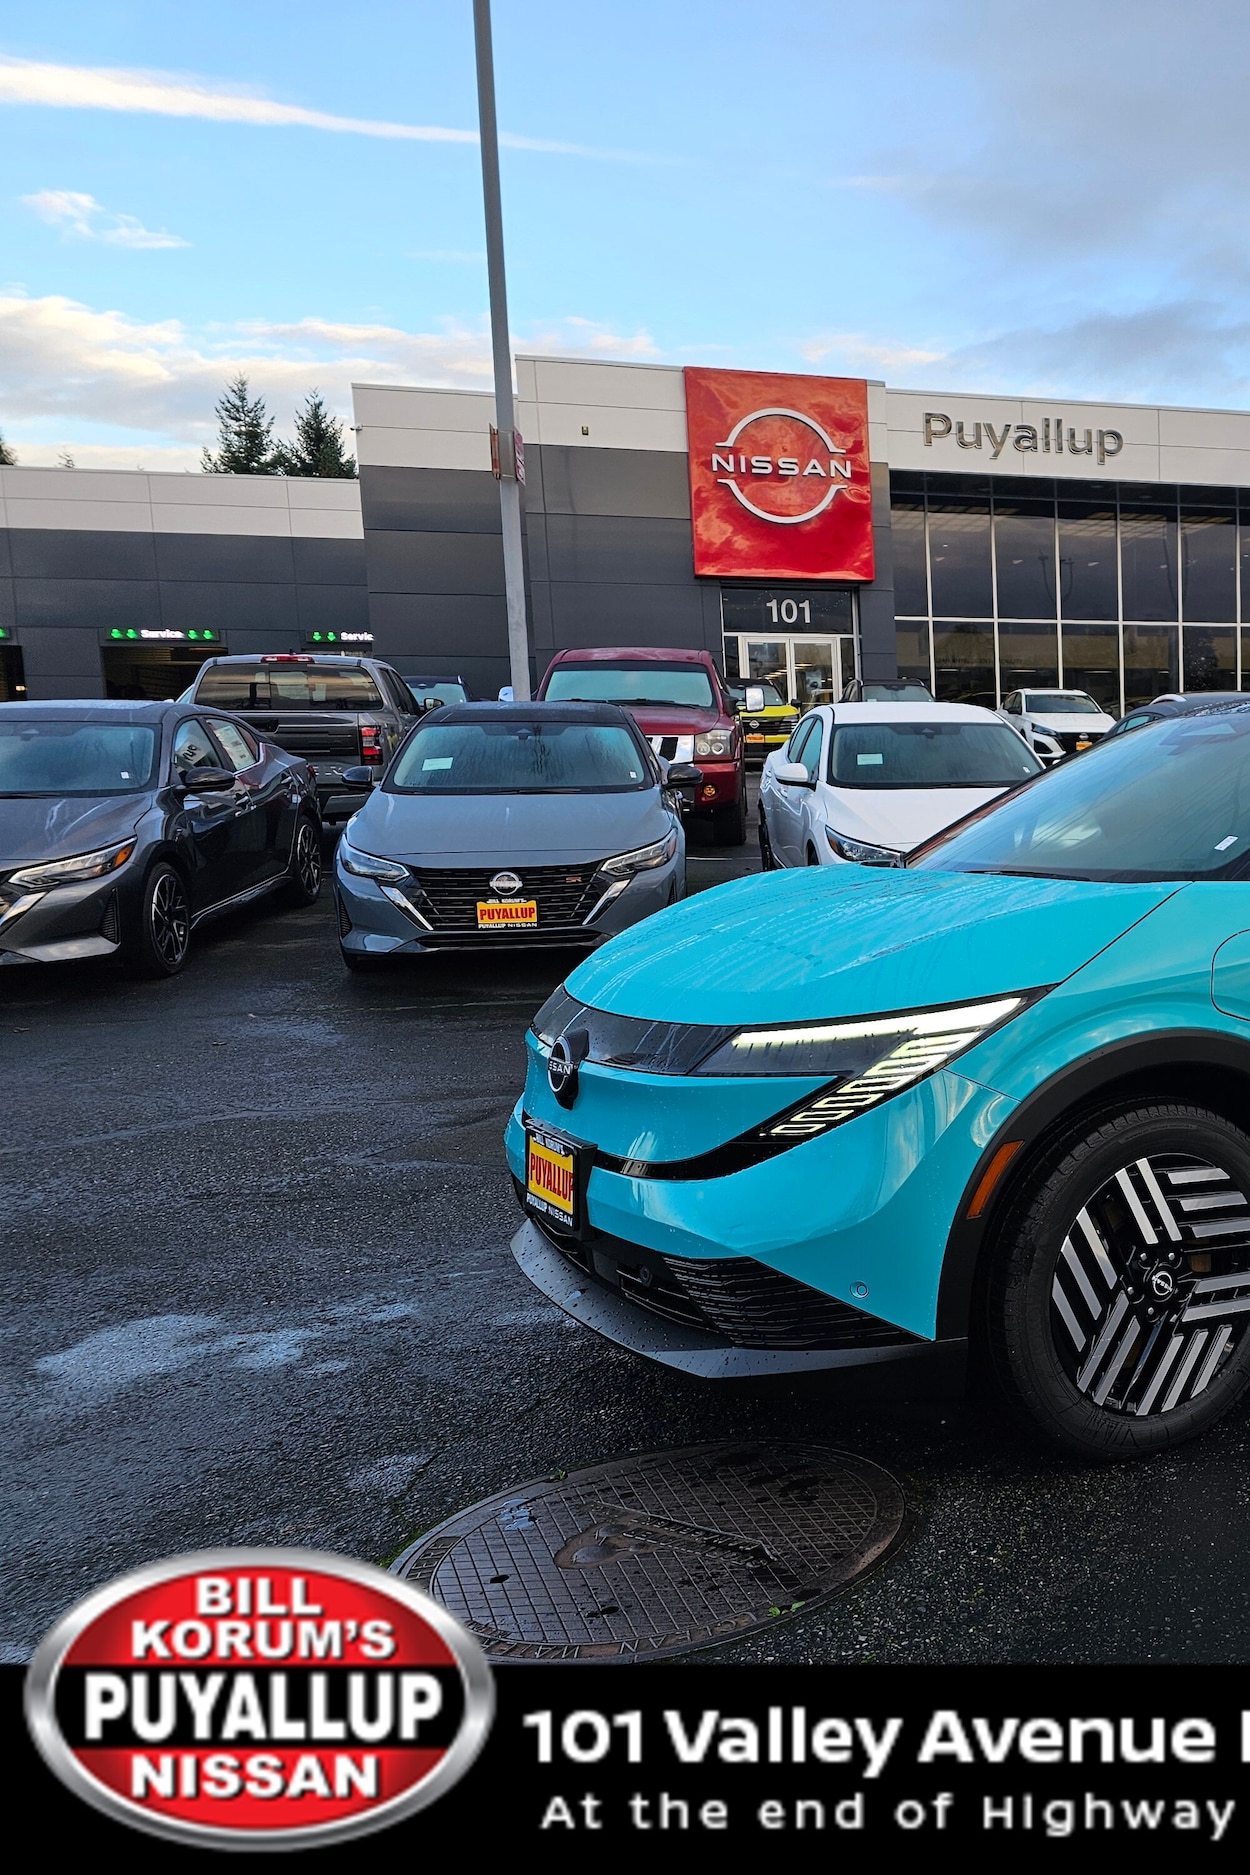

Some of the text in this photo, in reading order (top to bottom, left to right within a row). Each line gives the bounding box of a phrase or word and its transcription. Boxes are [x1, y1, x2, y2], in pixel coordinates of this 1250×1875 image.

[922, 411, 1124, 466] Puyallup
[711, 453, 852, 479] NISSAN
[766, 599, 812, 624] 101
[479, 907, 536, 920] PUYALLUP
